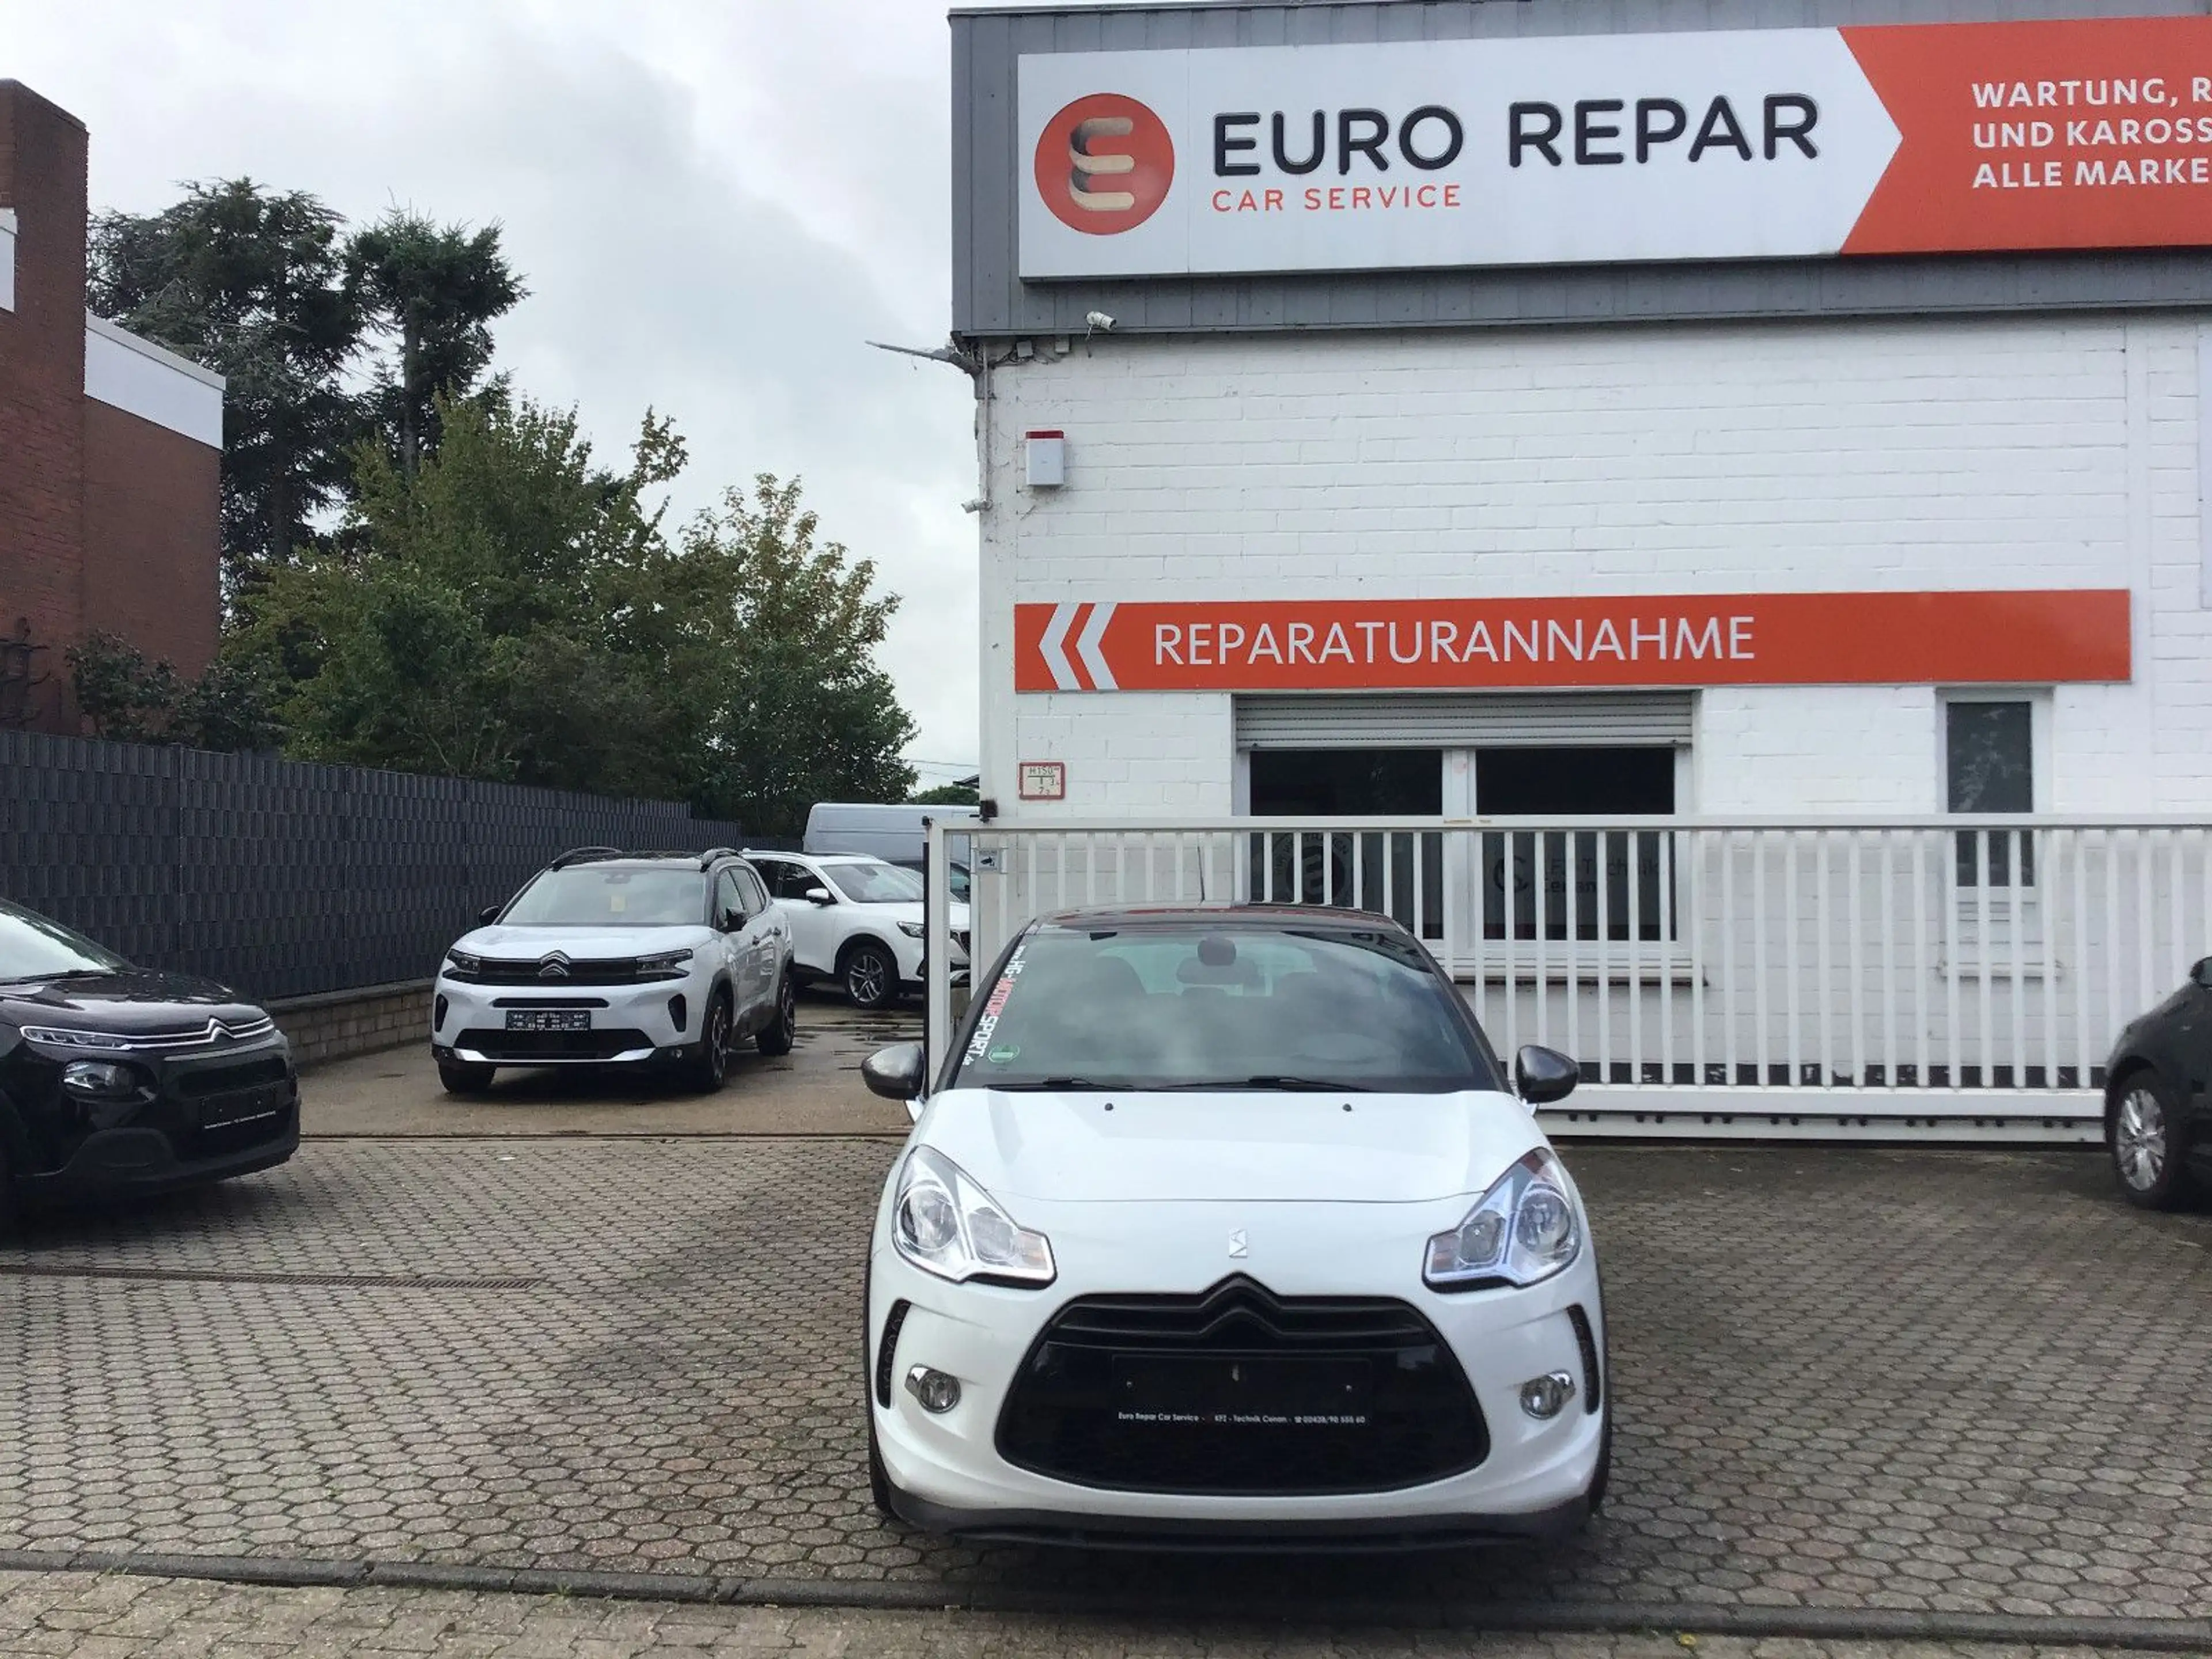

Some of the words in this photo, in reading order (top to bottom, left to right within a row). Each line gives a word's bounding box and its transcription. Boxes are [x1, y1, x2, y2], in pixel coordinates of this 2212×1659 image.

[1972, 78, 2179, 109] WARTUNG,
[1214, 105, 1464, 177] EURO
[1509, 93, 1819, 168] REPAR
[1973, 121, 2055, 149] UND
[2066, 117, 2212, 147] KAROSS
[1972, 161, 2063, 188] ALLE
[2074, 157, 2210, 186] MARKE
[1213, 188, 1283, 213] CAR
[1304, 184, 1462, 210] SERVICE
[1155, 616, 1755, 666] REPARATURANNAHME
[1118, 1412, 1134, 1420] Euro
[1158, 1413, 1171, 1421] Car
[1172, 1413, 1199, 1422] Service
